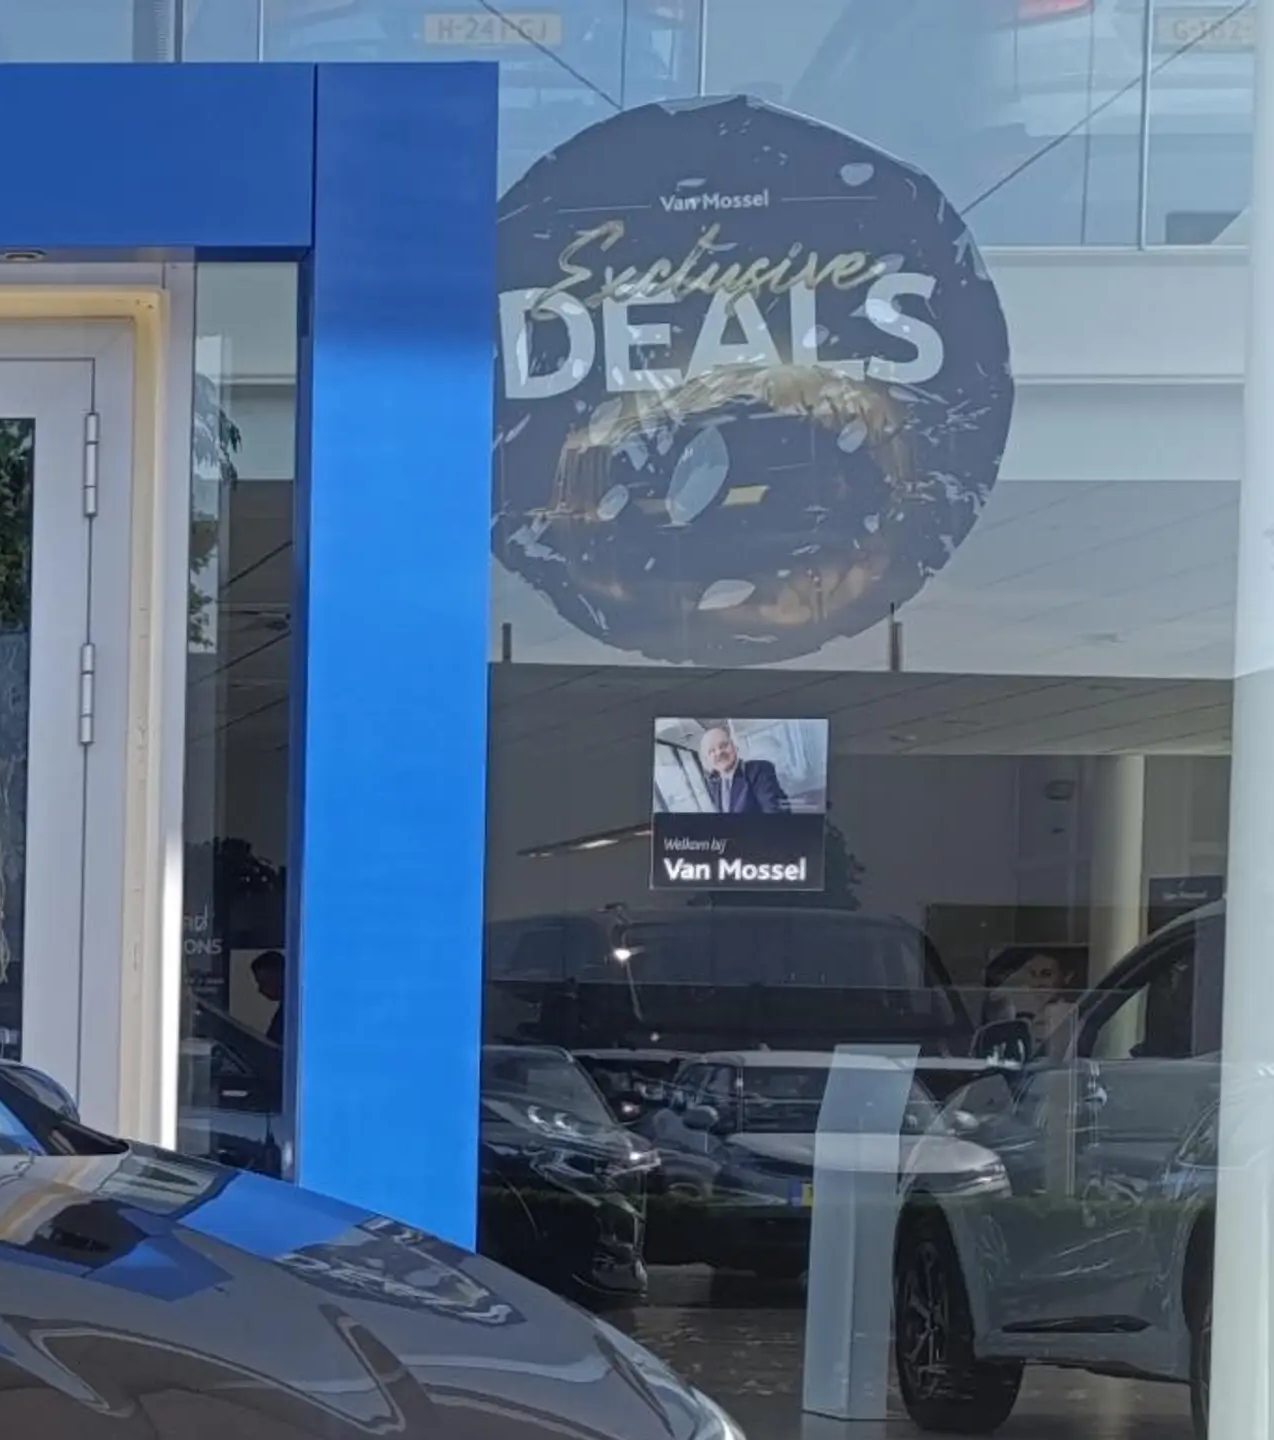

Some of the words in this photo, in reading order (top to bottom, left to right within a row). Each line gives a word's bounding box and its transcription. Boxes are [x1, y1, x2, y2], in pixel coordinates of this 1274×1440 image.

[660, 196, 699, 212] Van
[702, 190, 770, 211] Mossel
[498, 272, 945, 399] DEALS
[664, 858, 710, 880] Van
[718, 856, 806, 880] Mossel
